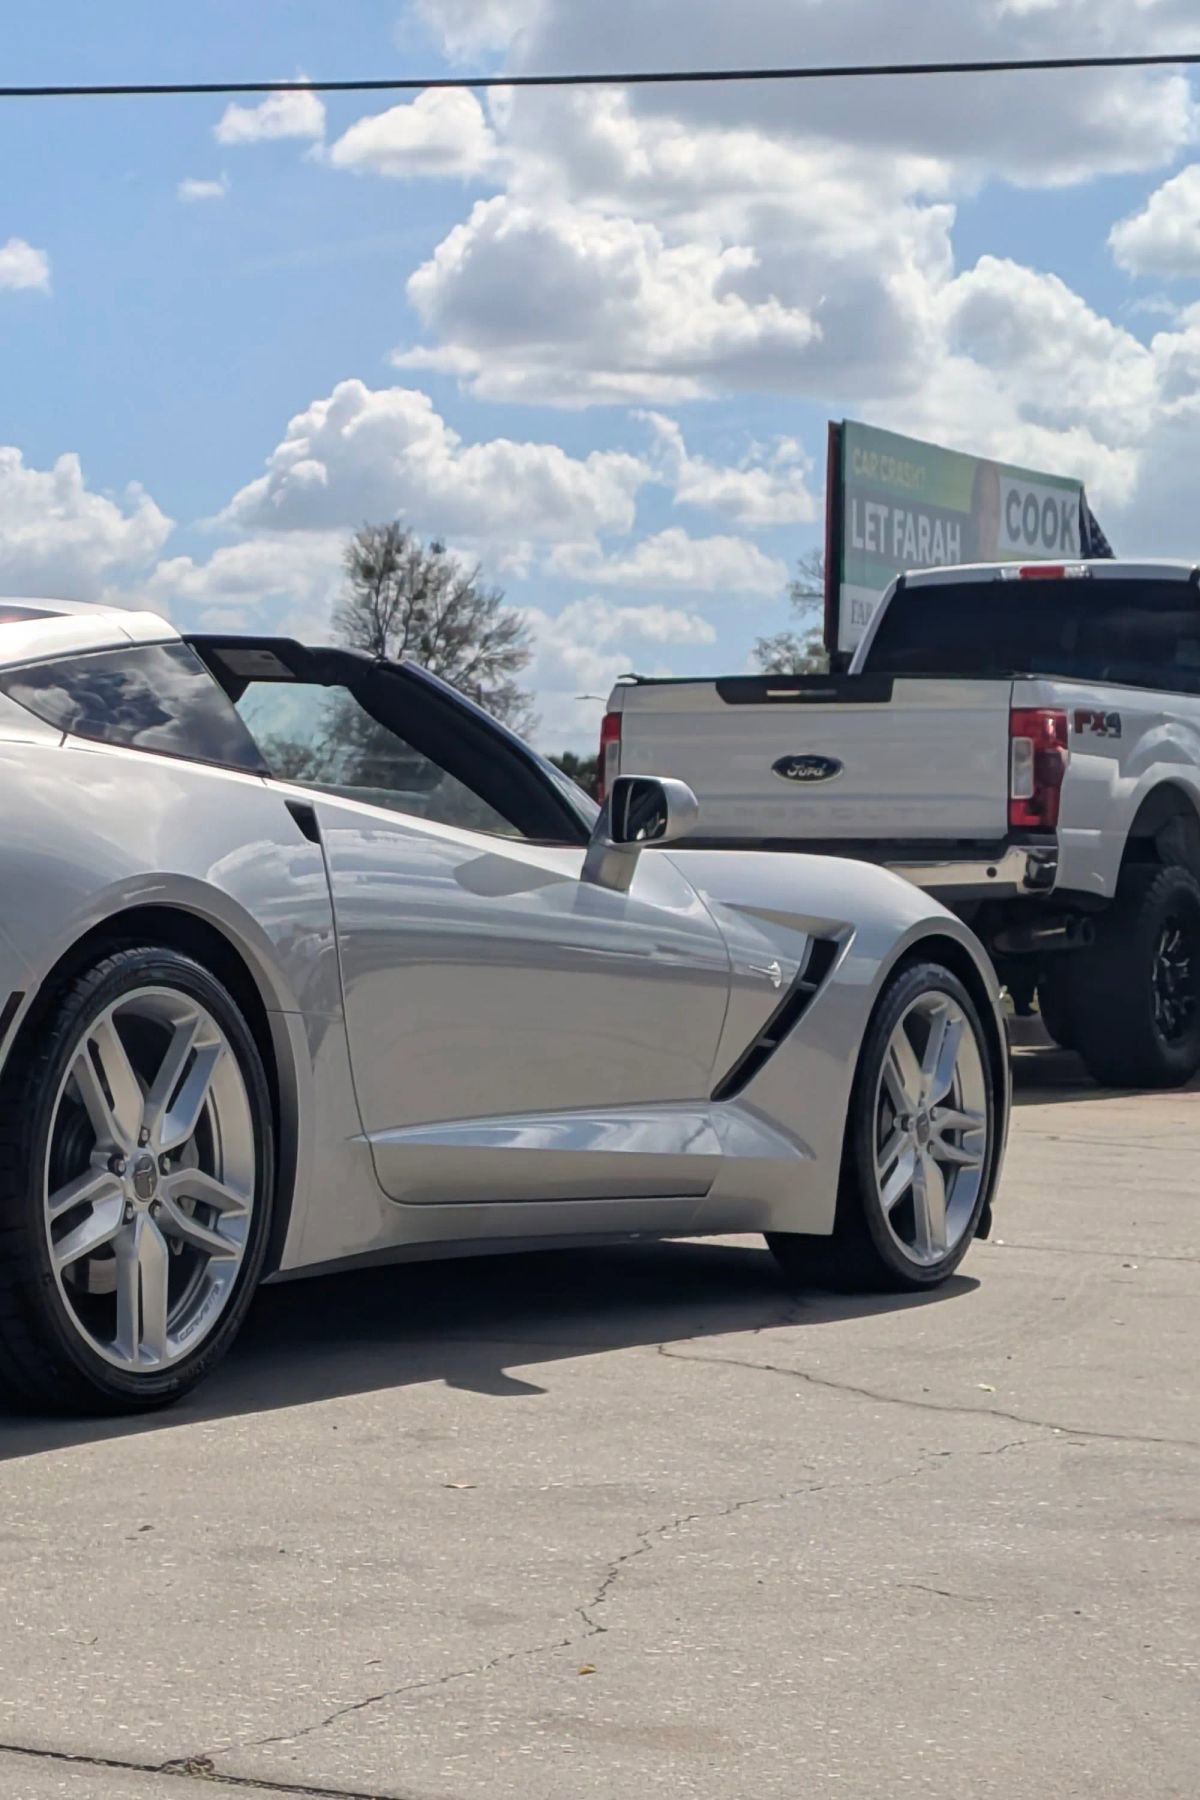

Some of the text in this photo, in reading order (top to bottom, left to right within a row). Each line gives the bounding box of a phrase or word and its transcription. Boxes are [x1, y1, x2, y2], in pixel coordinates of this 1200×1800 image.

[852, 499, 961, 564] LET FARAH
[1006, 489, 1078, 552] COOK
[1074, 709, 1121, 738] FX4
[786, 759, 828, 777] Ford
